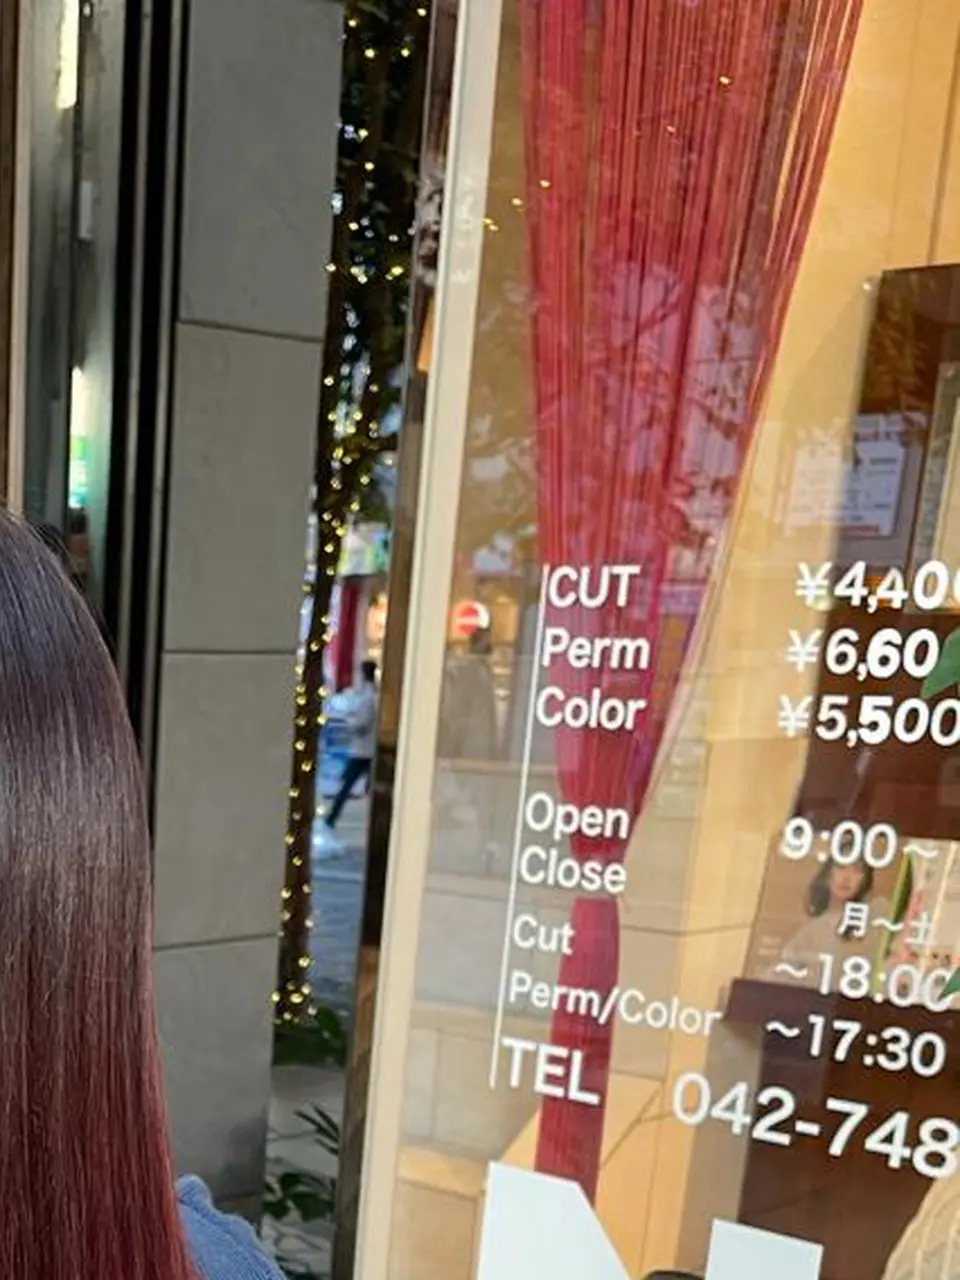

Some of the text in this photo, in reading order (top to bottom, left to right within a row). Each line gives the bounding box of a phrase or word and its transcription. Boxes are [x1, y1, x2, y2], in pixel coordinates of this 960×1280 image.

[549, 560, 960, 613] CUT ¥4,40
[542, 627, 650, 669] Perm
[536, 686, 647, 730] Color
[525, 791, 630, 841] Open
[519, 845, 627, 894] Close
[513, 914, 576, 956] Cut
[509, 969, 723, 1036] Perm/Color
[501, 1036, 960, 1179] TEL 042-748
